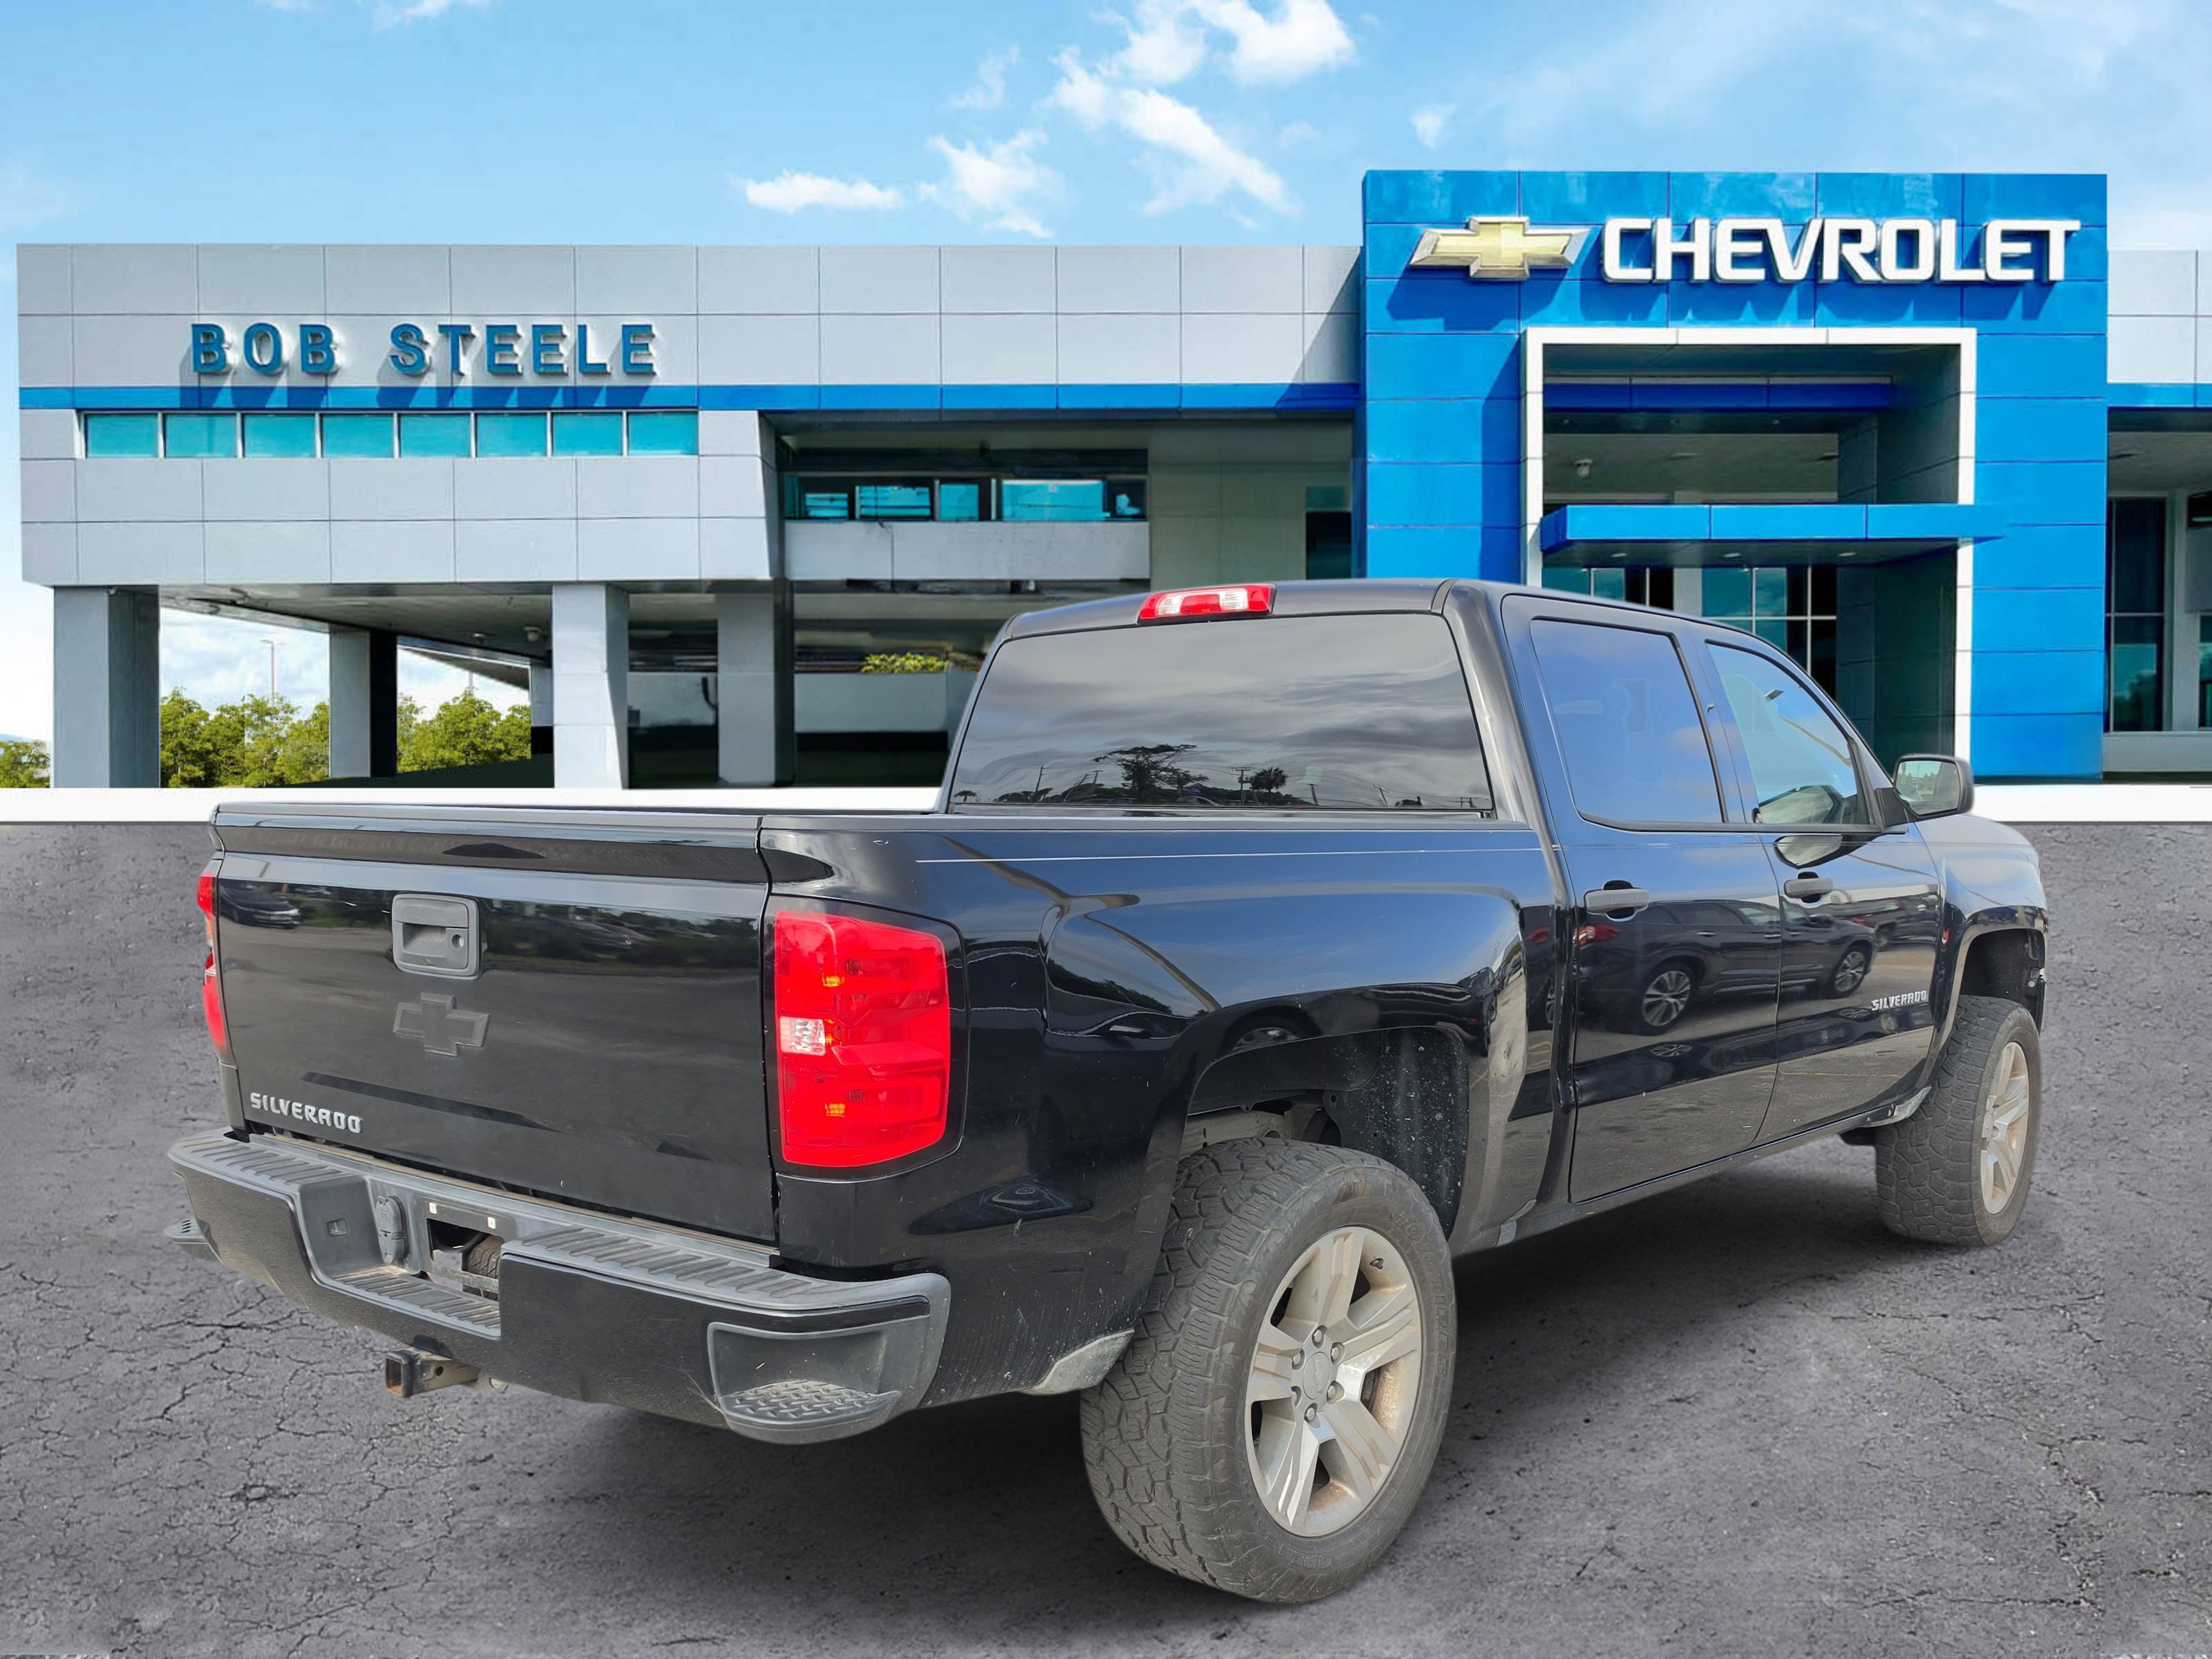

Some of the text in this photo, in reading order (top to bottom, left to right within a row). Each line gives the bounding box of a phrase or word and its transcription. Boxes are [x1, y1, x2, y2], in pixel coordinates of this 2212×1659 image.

[1602, 217, 2082, 283] CHEVROLET
[191, 322, 656, 376] BOB STEELE
[1871, 990, 1927, 1011] SILVERADO
[250, 1092, 362, 1134] SILVERADO
